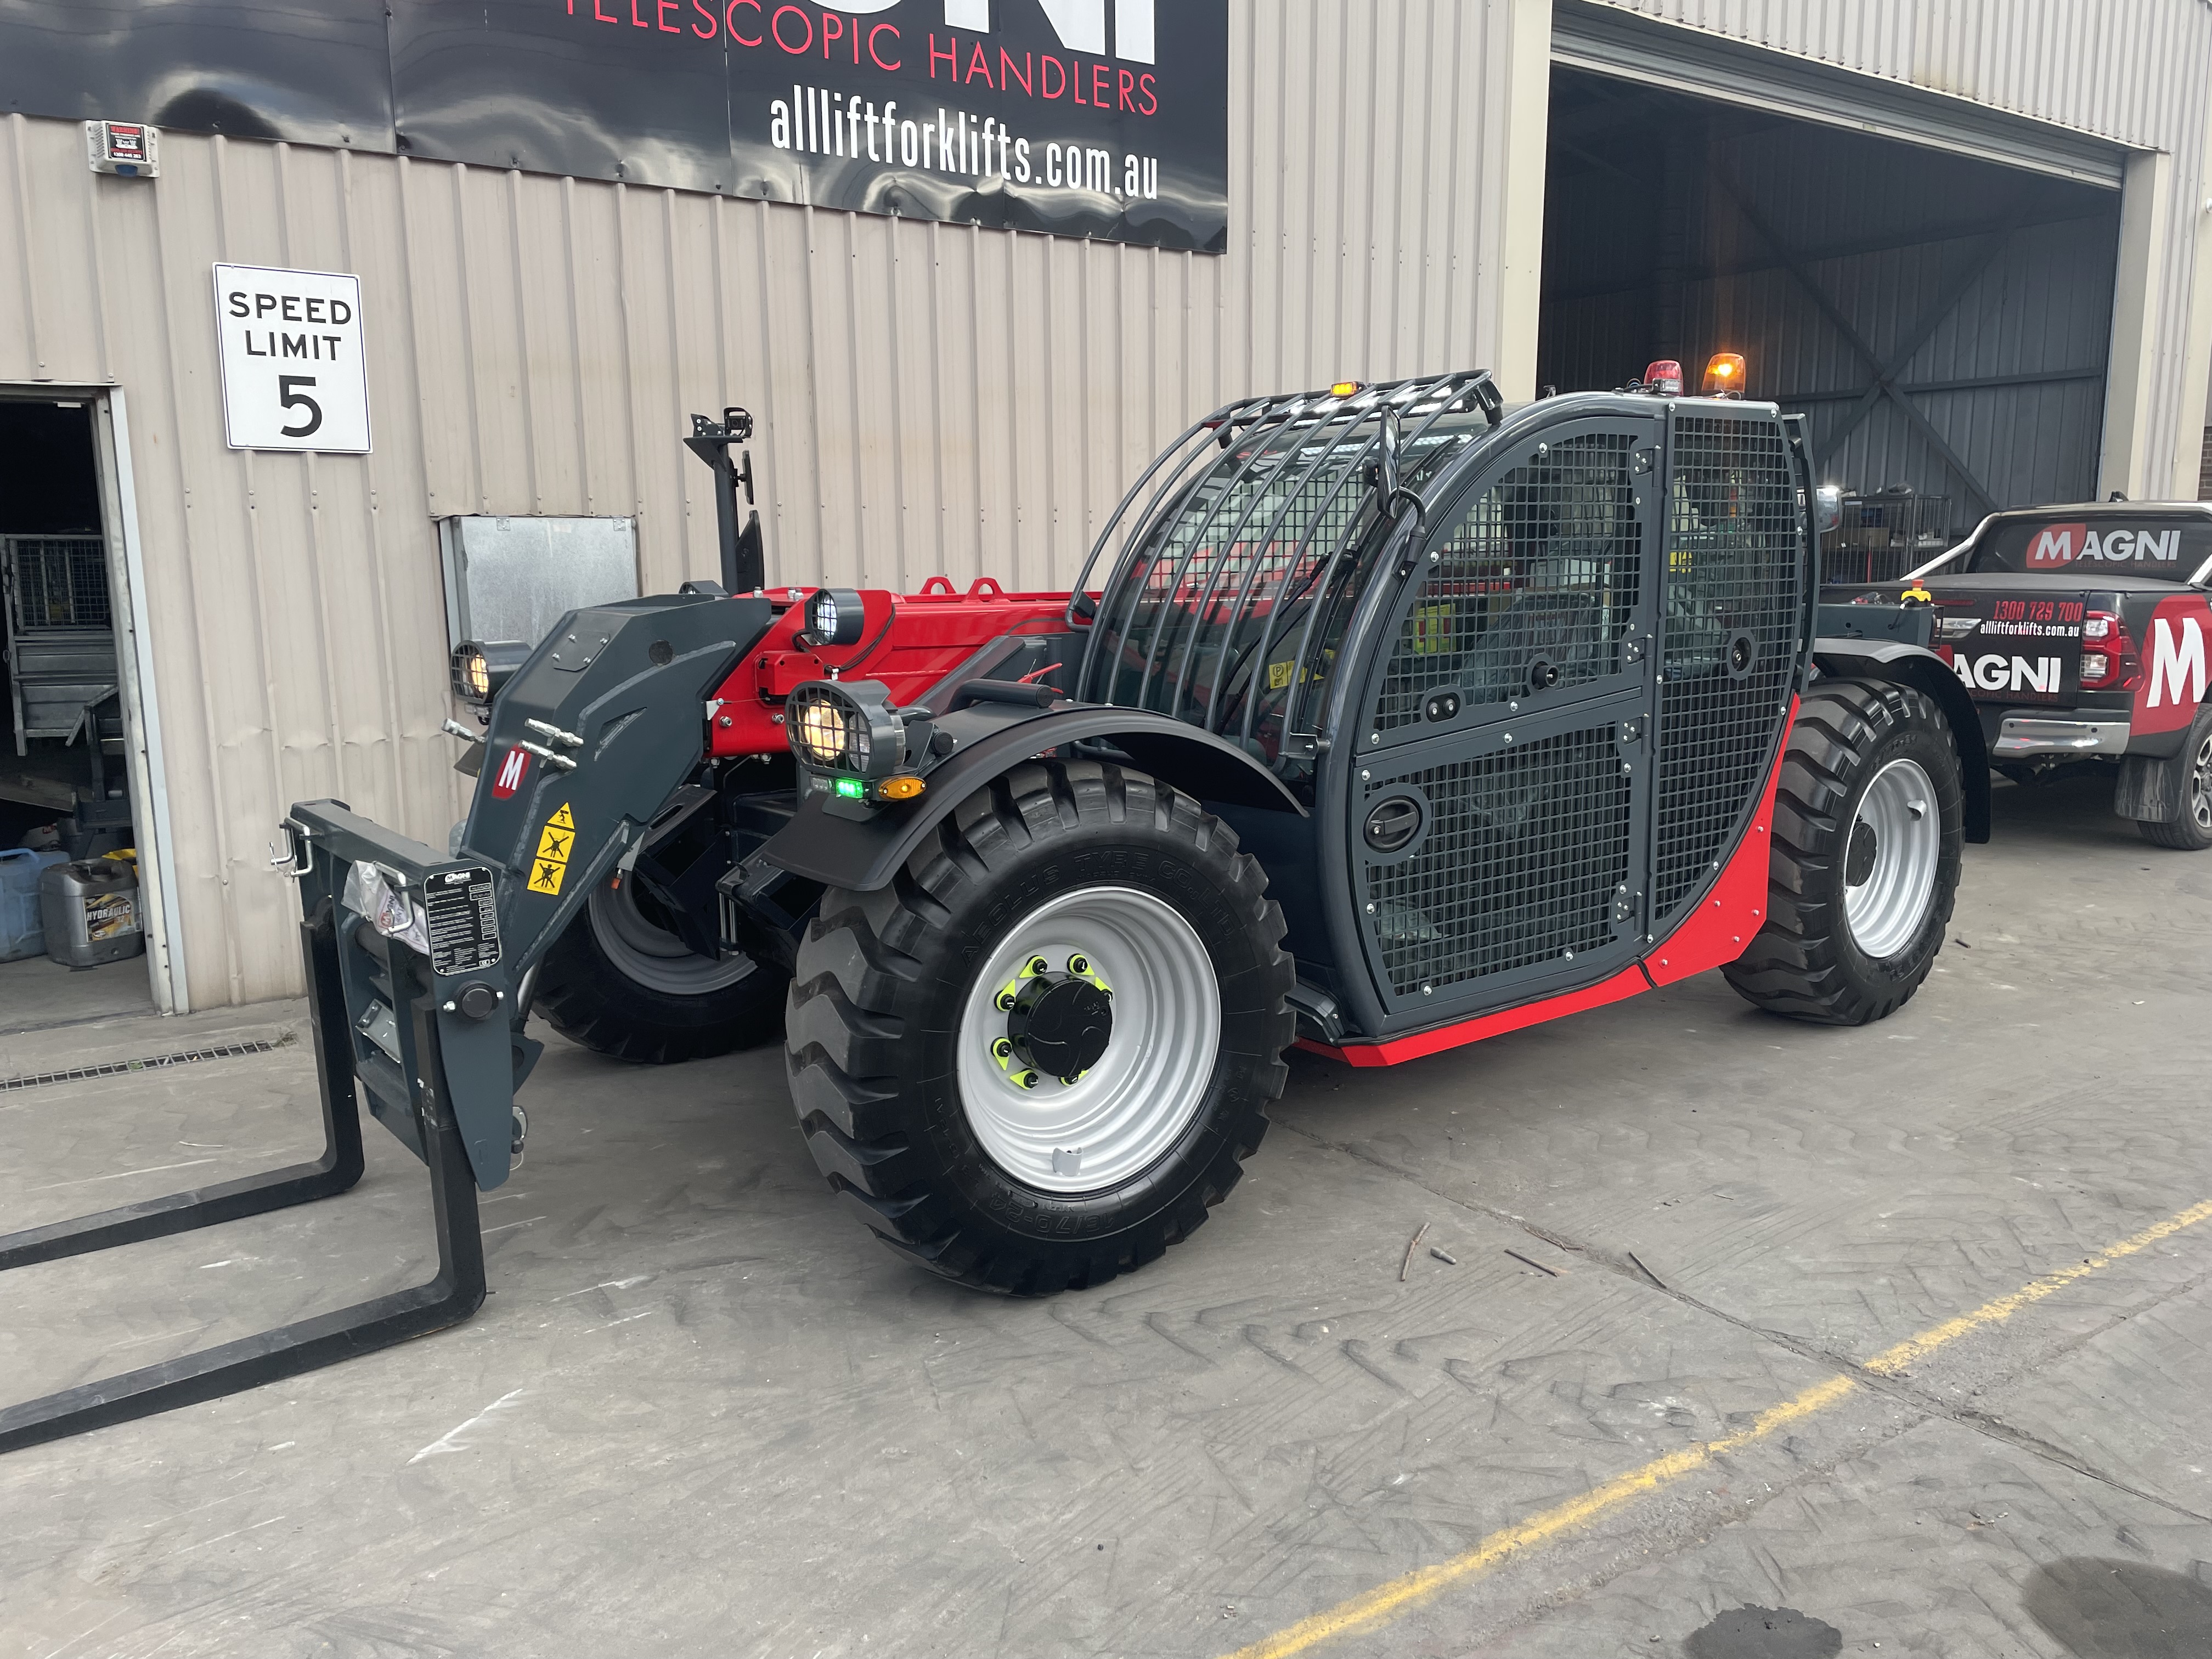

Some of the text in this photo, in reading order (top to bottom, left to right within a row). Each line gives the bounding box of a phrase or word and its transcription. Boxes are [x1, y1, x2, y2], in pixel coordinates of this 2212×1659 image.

[928, 33, 1158, 116] HANDLERS
[770, 84, 1158, 200] allliftforklifts.com.au
[229, 291, 351, 325] SPEED
[245, 330, 341, 361] LIMIT
[278, 374, 323, 437] 5
[2034, 529, 2181, 561] MAGNI
[2130, 560, 2177, 568] HANDLERS
[1980, 620, 2080, 637] allliftforklifts.com.au
[1993, 600, 2084, 623] 1300 729 700
[1954, 653, 2062, 693] AGNI
[2146, 617, 2206, 708] M
[2006, 691, 2058, 702] HANDLERS
[498, 750, 525, 791] M
[445, 872, 471, 882] MAGNI
[87, 905, 131, 921] HYDRAULIC
[960, 864, 1062, 968] AEOLUS
[1073, 850, 1149, 872] TYRE
[989, 1195, 1115, 1234] 16/70-24
